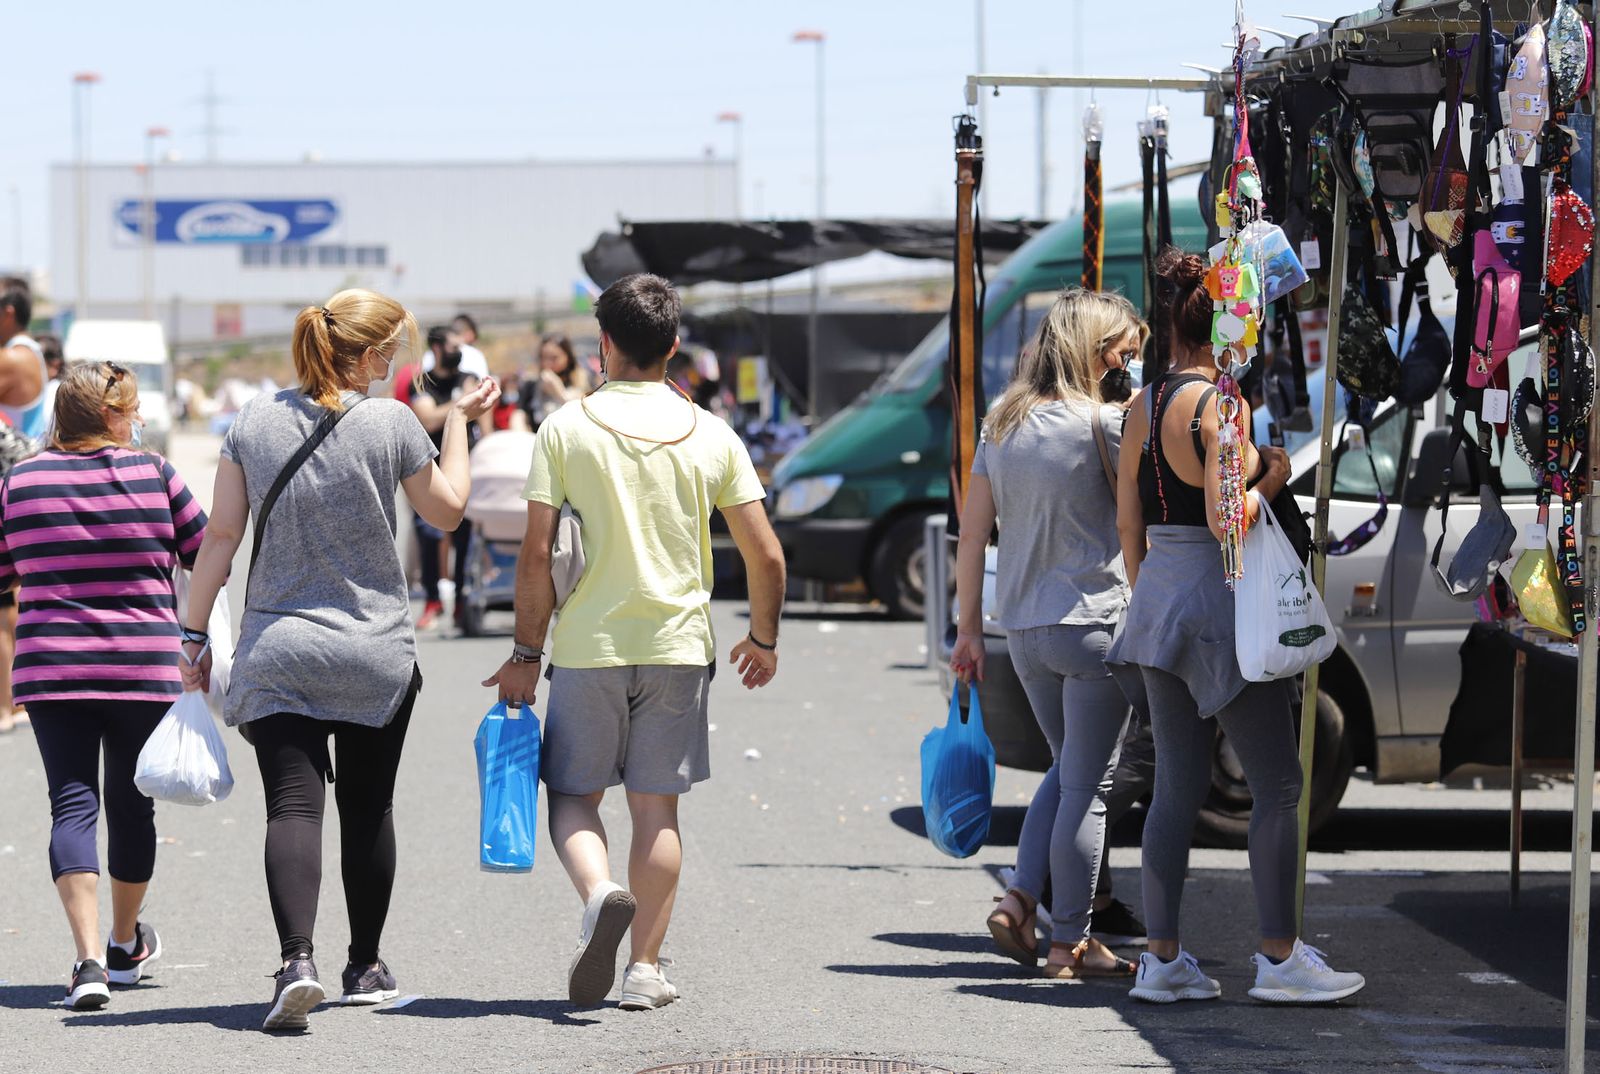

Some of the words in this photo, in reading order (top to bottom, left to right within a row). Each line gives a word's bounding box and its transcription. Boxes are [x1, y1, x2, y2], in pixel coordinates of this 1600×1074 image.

[1548, 345, 1559, 387] LOVE
[1548, 393, 1559, 434] LOVE
[1547, 438, 1558, 472] OVE
[1564, 505, 1575, 548] LOVE
